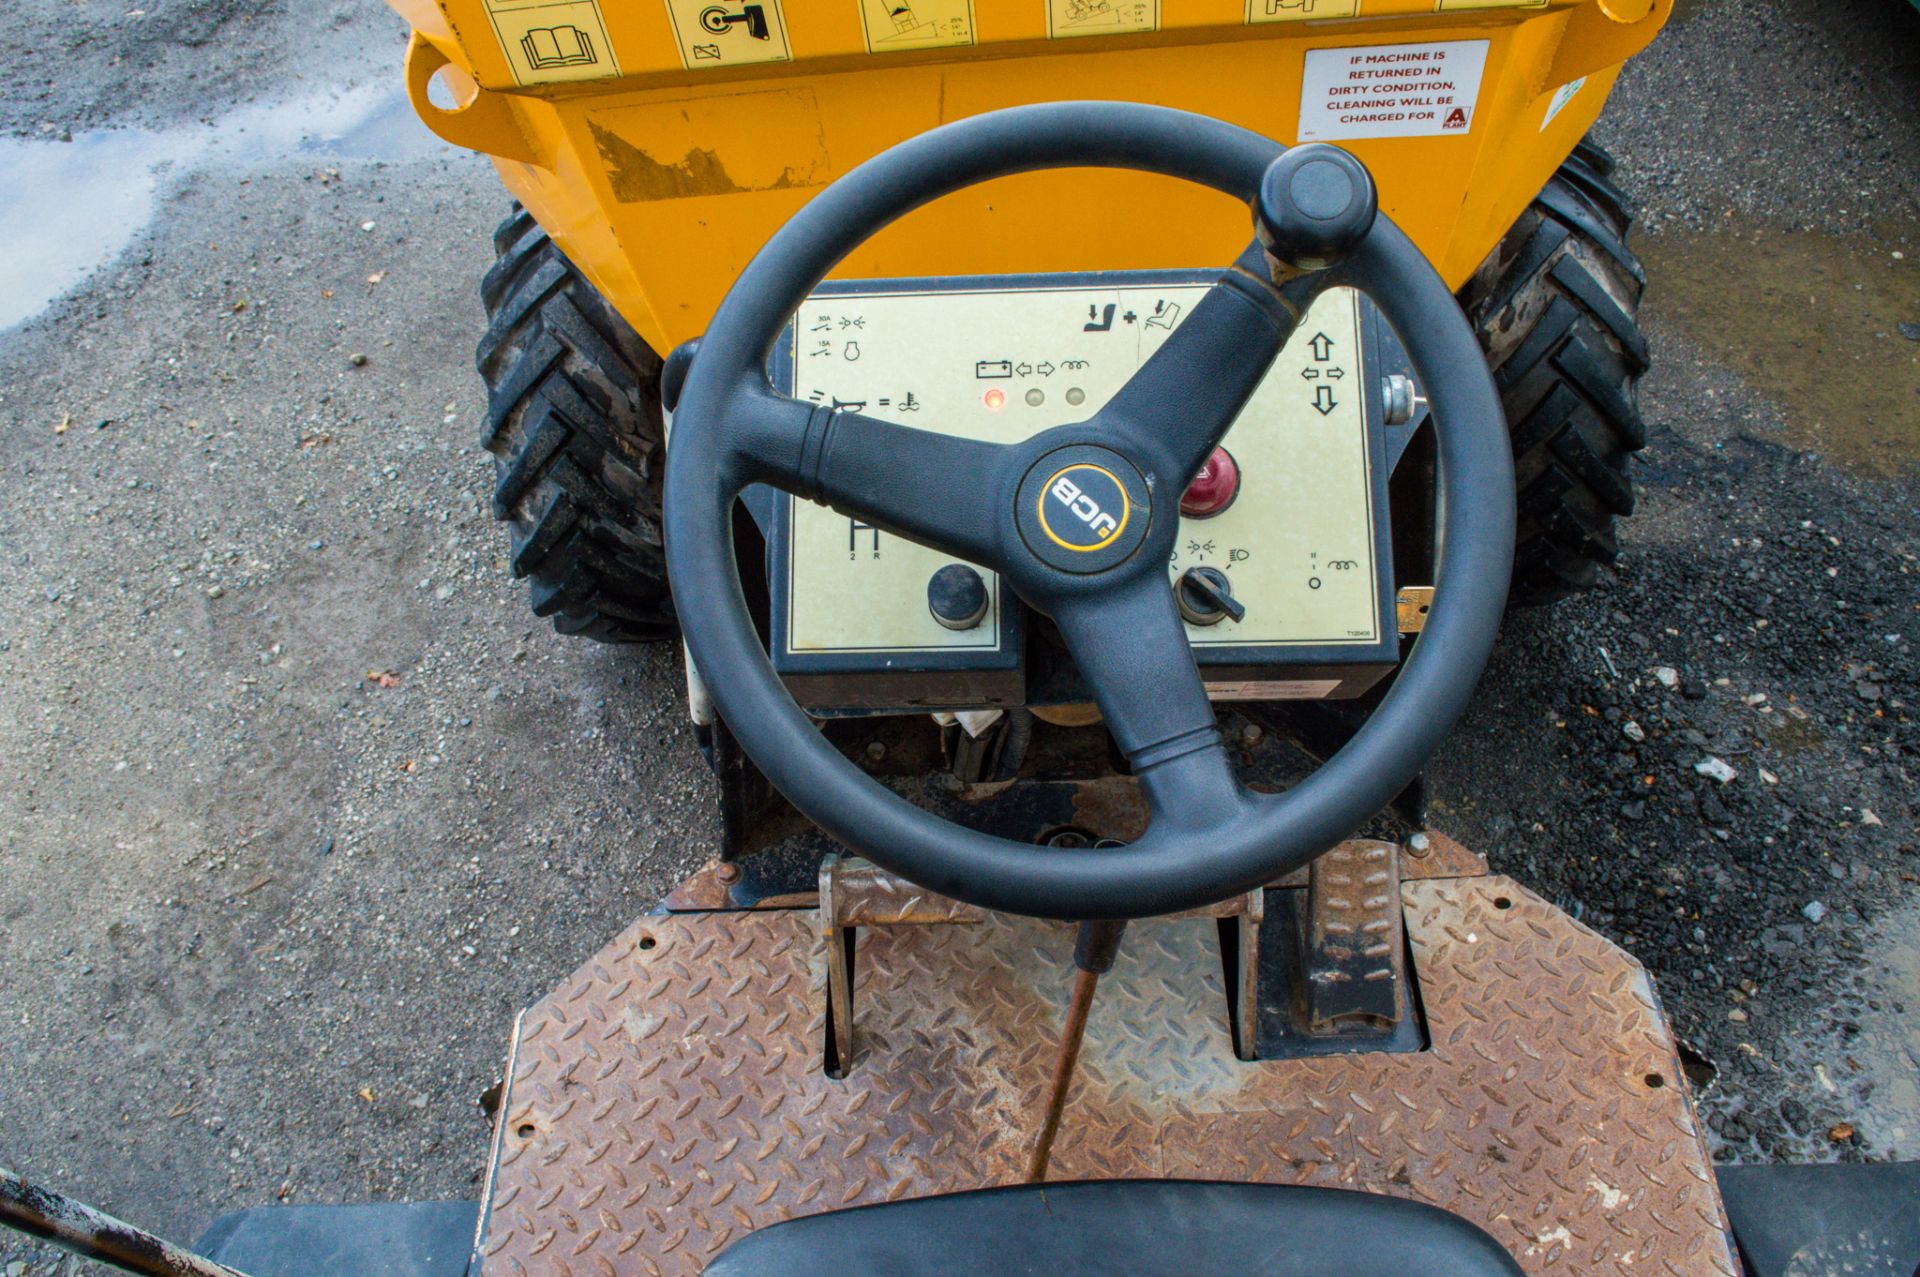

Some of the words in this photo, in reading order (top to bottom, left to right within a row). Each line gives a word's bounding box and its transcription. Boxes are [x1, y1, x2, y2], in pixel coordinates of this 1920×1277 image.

[1350, 56, 1362, 65] IF
[1365, 53, 1429, 64] MACHINE
[1433, 51, 1446, 60] IS
[1349, 68, 1423, 80] RETURNED
[1426, 66, 1441, 75] IN
[1328, 86, 1369, 96] DIRTY
[1372, 81, 1455, 94] CONDITION,
[1326, 99, 1396, 110] CLEANING
[1400, 97, 1433, 106] WILL
[1437, 95, 1454, 104] BE
[1340, 113, 1404, 124] CHARGED
[1408, 112, 1435, 120] FOR
[1052, 477, 1116, 538] JCB
[850, 552, 856, 561] 2
[873, 552, 881, 560] R
